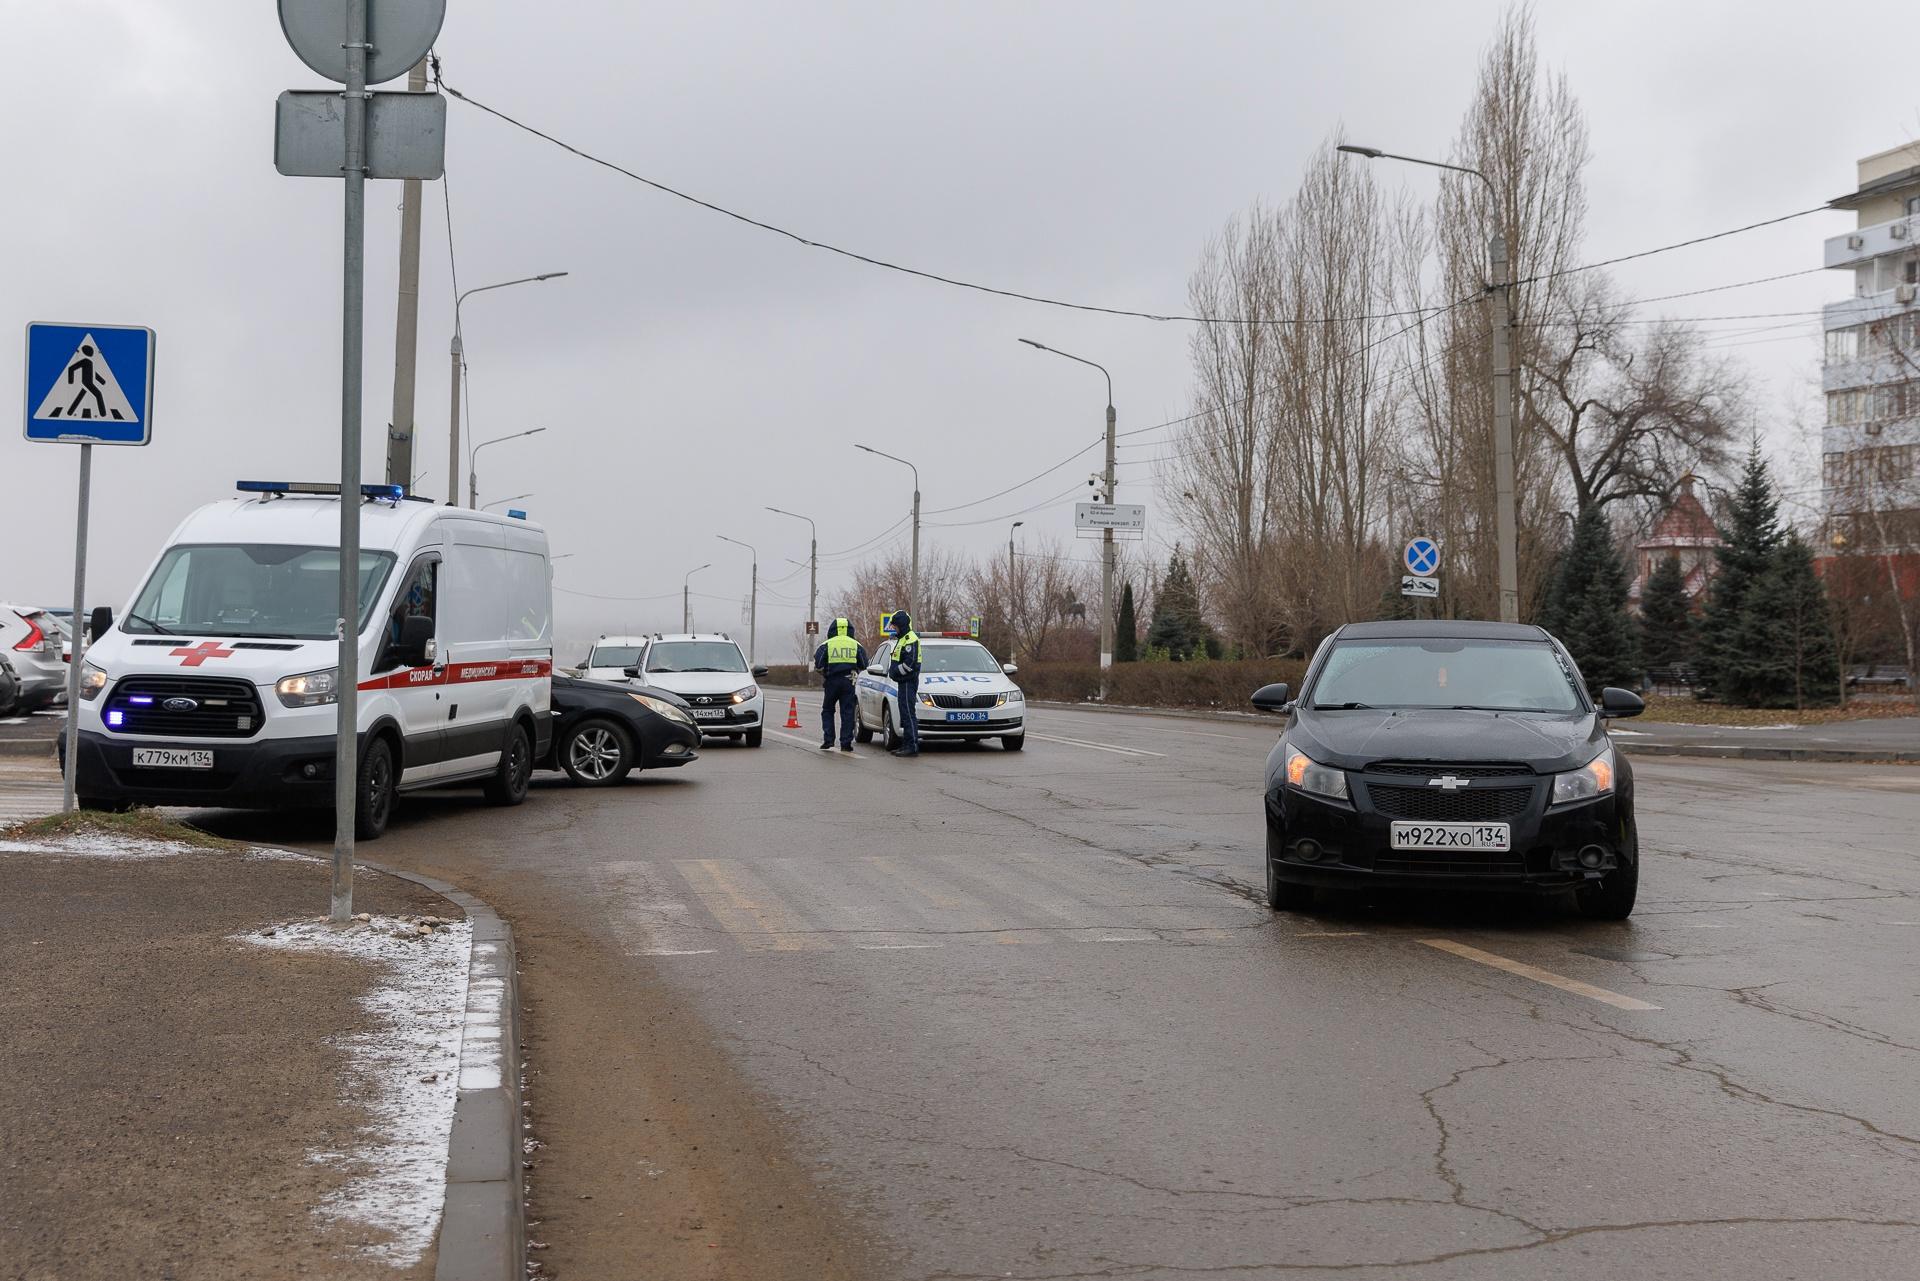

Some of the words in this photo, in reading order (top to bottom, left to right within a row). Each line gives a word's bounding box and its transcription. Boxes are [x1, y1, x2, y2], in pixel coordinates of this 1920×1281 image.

[831, 647, 857, 659] ДПС
[409, 669, 433, 681] СКОРАЯ
[460, 666, 497, 679] МЕДИЦИНСКАЯ
[924, 675, 992, 685] ДПС
[957, 712, 975, 720] 5060
[137, 750, 188, 765] К779КМ
[190, 751, 210, 762] 134
[1397, 827, 1472, 846] М922ХО
[1475, 828, 1504, 842] 134
